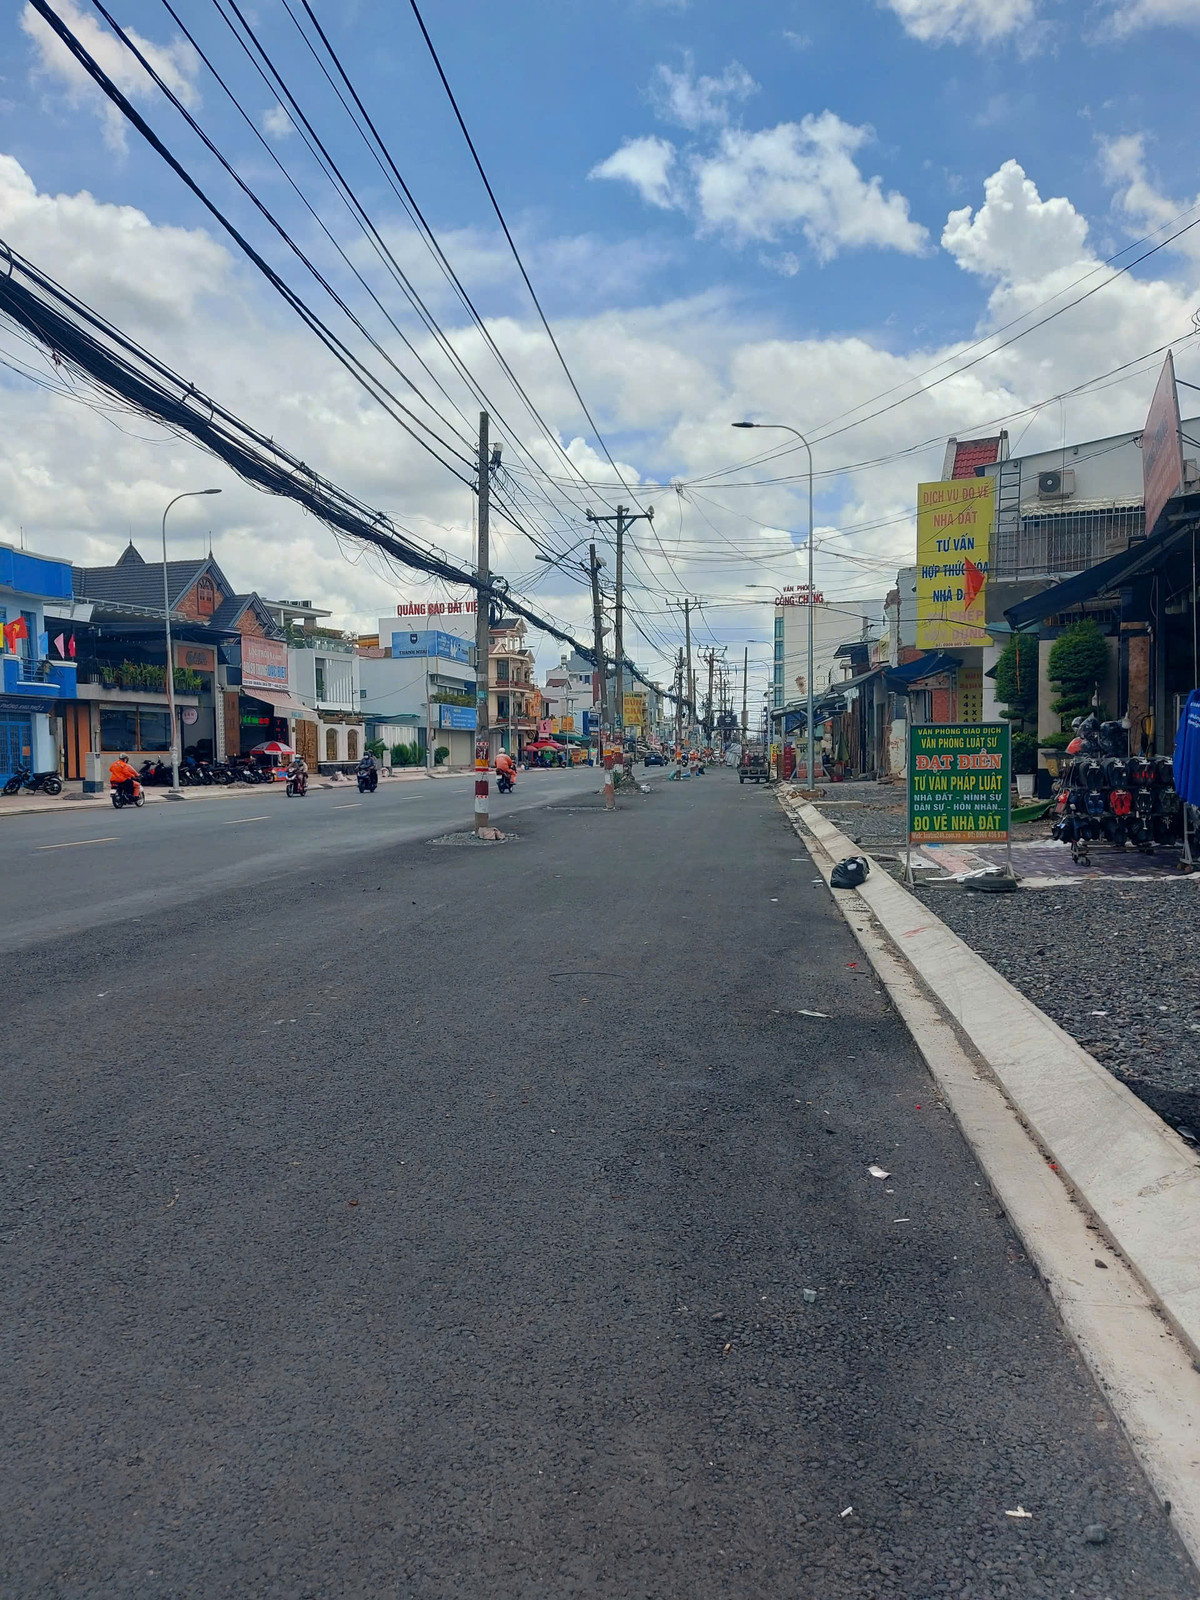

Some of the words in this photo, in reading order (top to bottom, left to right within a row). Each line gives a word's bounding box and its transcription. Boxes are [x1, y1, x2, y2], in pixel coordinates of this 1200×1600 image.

[933, 510, 954, 528] NHÀ
[958, 506, 978, 525] ĐẤT
[936, 536, 951, 553] TƯ
[953, 532, 975, 551] VẤN
[921, 564, 940, 581] HỢP
[933, 585, 953, 602] NHÀ
[397, 601, 426, 616] QUẢNG
[465, 598, 478, 614] VIỆ
[918, 727, 933, 735] VĂN
[935, 727, 961, 735] PHÒNG
[963, 727, 981, 735] GIAO
[983, 727, 1001, 736] DỊCH
[921, 736, 936, 749] VĂN
[938, 735, 965, 749] PHÒNG
[966, 735, 985, 750] LUẬT
[987, 736, 998, 748] SƯ
[916, 754, 954, 774] ĐẠT
[957, 748, 1003, 770] ĐIỀN
[914, 774, 927, 791] TƯ
[928, 771, 948, 791] VẤN
[950, 772, 976, 791] PHÁP
[979, 771, 1003, 794] LUẬT
[914, 793, 933, 801] NHÀ
[935, 792, 953, 801] ĐẤT
[963, 792, 987, 801] HÌNH
[989, 793, 1003, 803] SỰ
[914, 803, 931, 811] DÂN
[933, 803, 945, 812] SỰ
[914, 816, 930, 831] ĐO
[933, 813, 948, 831] VẼ
[951, 812, 975, 831] NHÀ
[978, 811, 1001, 830] ĐẤT
